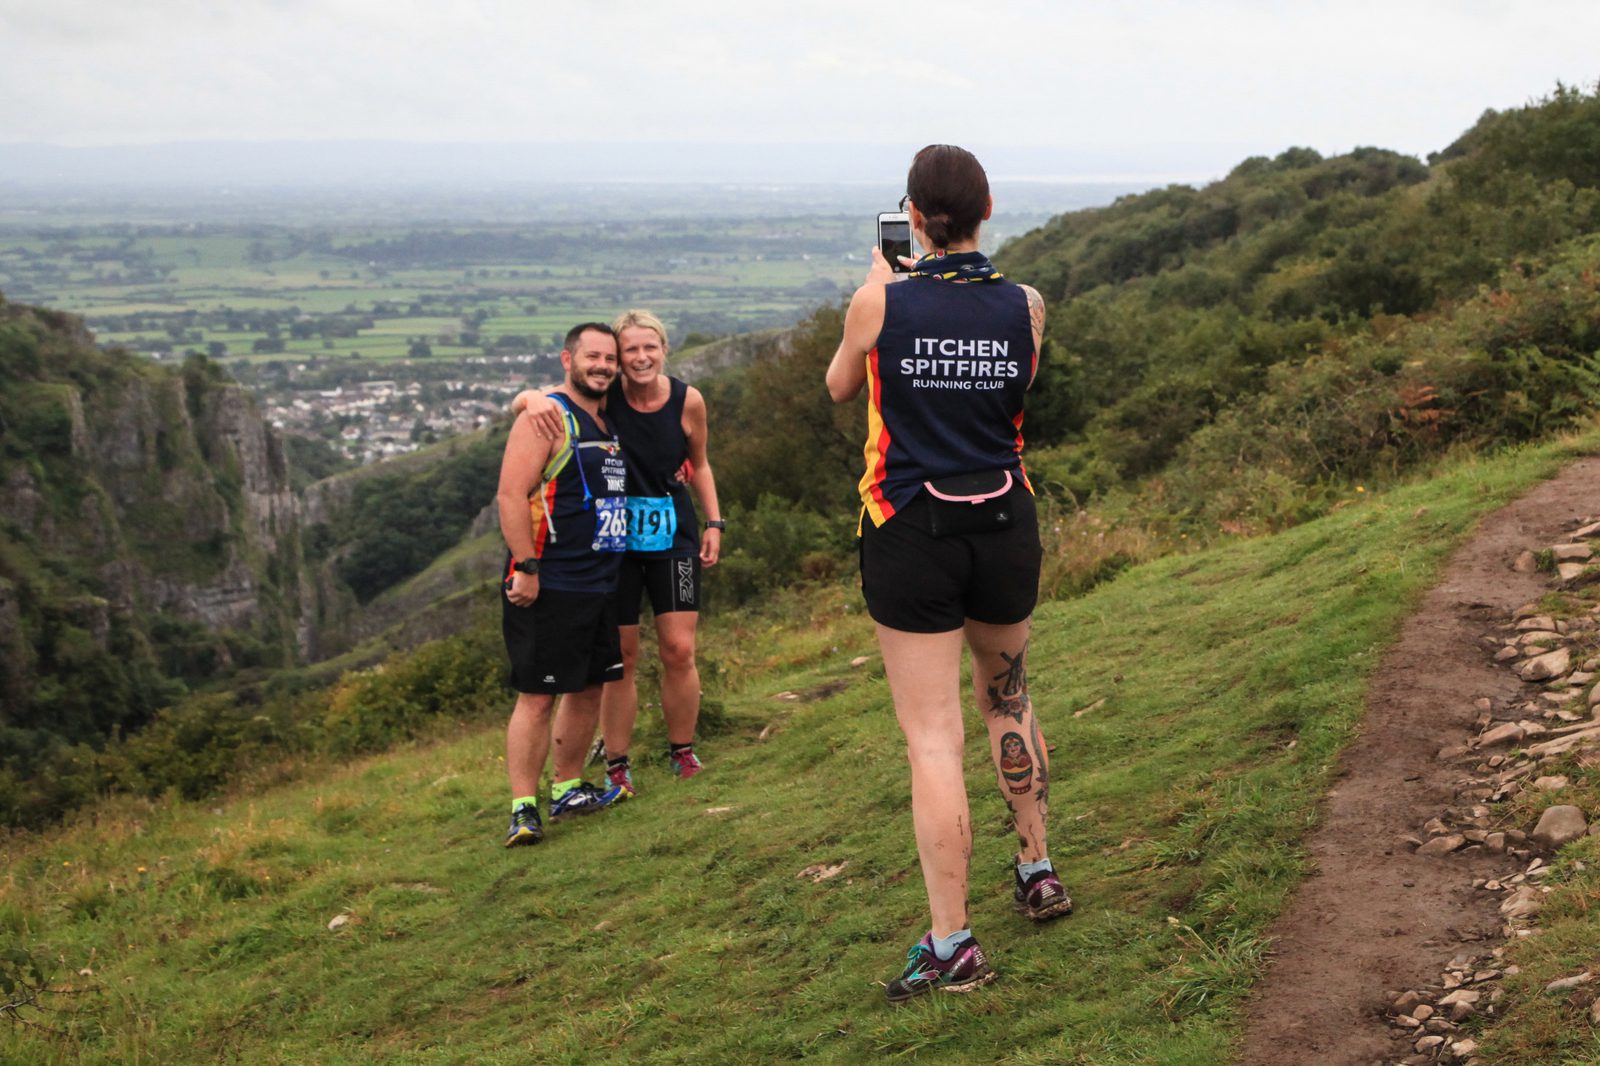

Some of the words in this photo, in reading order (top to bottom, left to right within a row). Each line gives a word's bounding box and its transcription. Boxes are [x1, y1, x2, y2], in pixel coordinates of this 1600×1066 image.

[914, 338, 1009, 357] ITCHEN
[900, 358, 1019, 378] SPITFIRES
[912, 379, 972, 390] RUNNING
[975, 380, 1005, 390] CLUB
